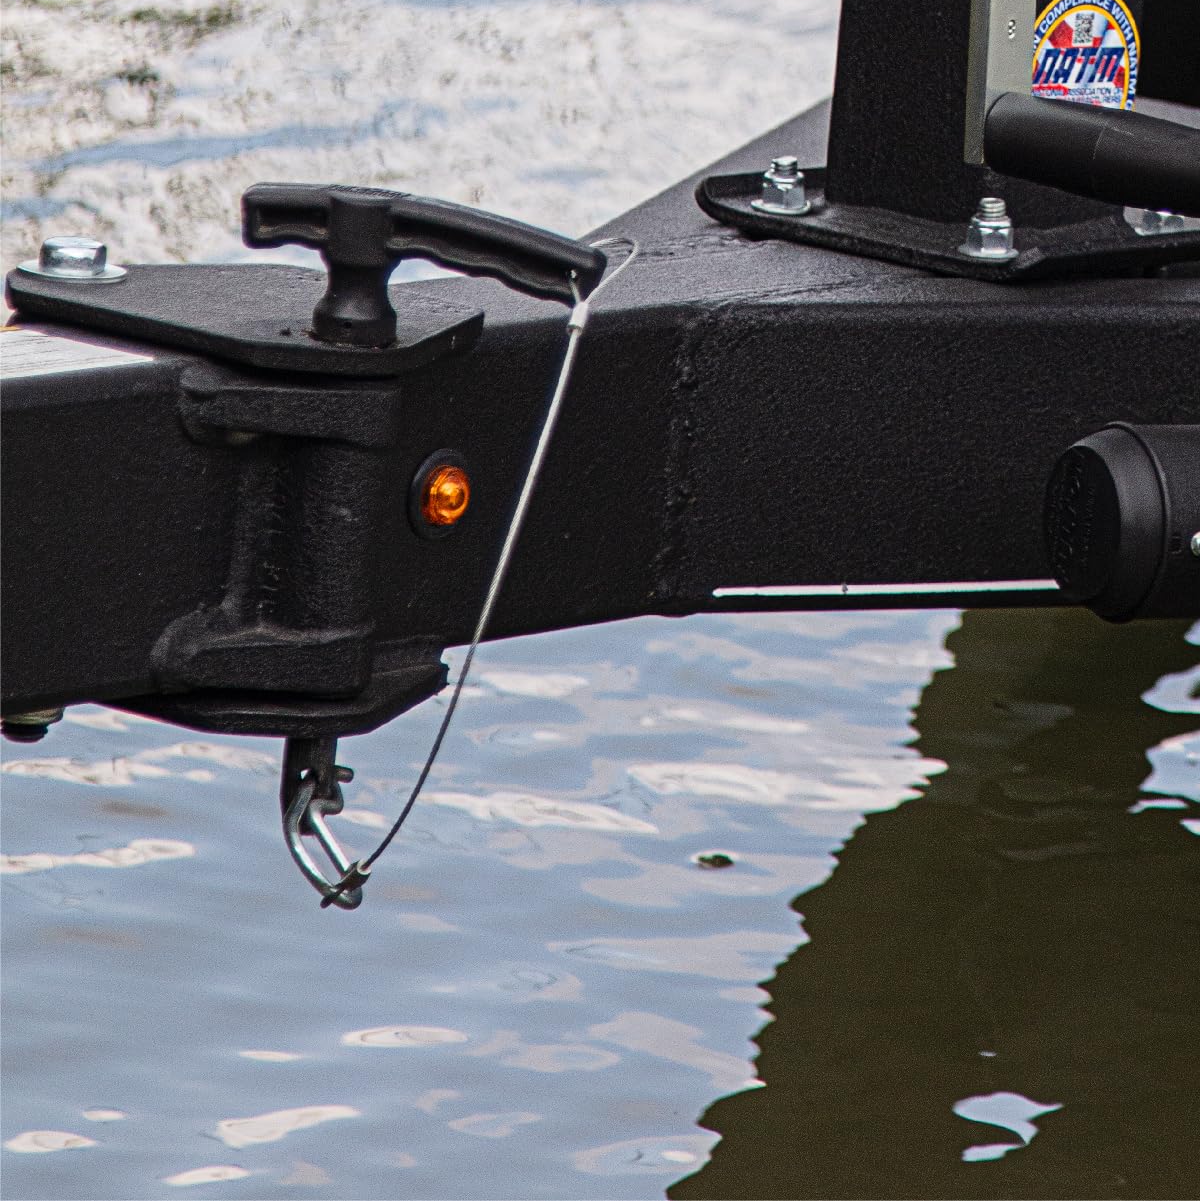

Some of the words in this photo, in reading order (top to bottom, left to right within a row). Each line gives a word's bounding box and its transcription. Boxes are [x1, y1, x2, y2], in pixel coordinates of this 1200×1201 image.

[1032, 47, 1126, 84] NATM
[1111, 6, 1134, 38] WITH
[1127, 44, 1137, 94] NATM
